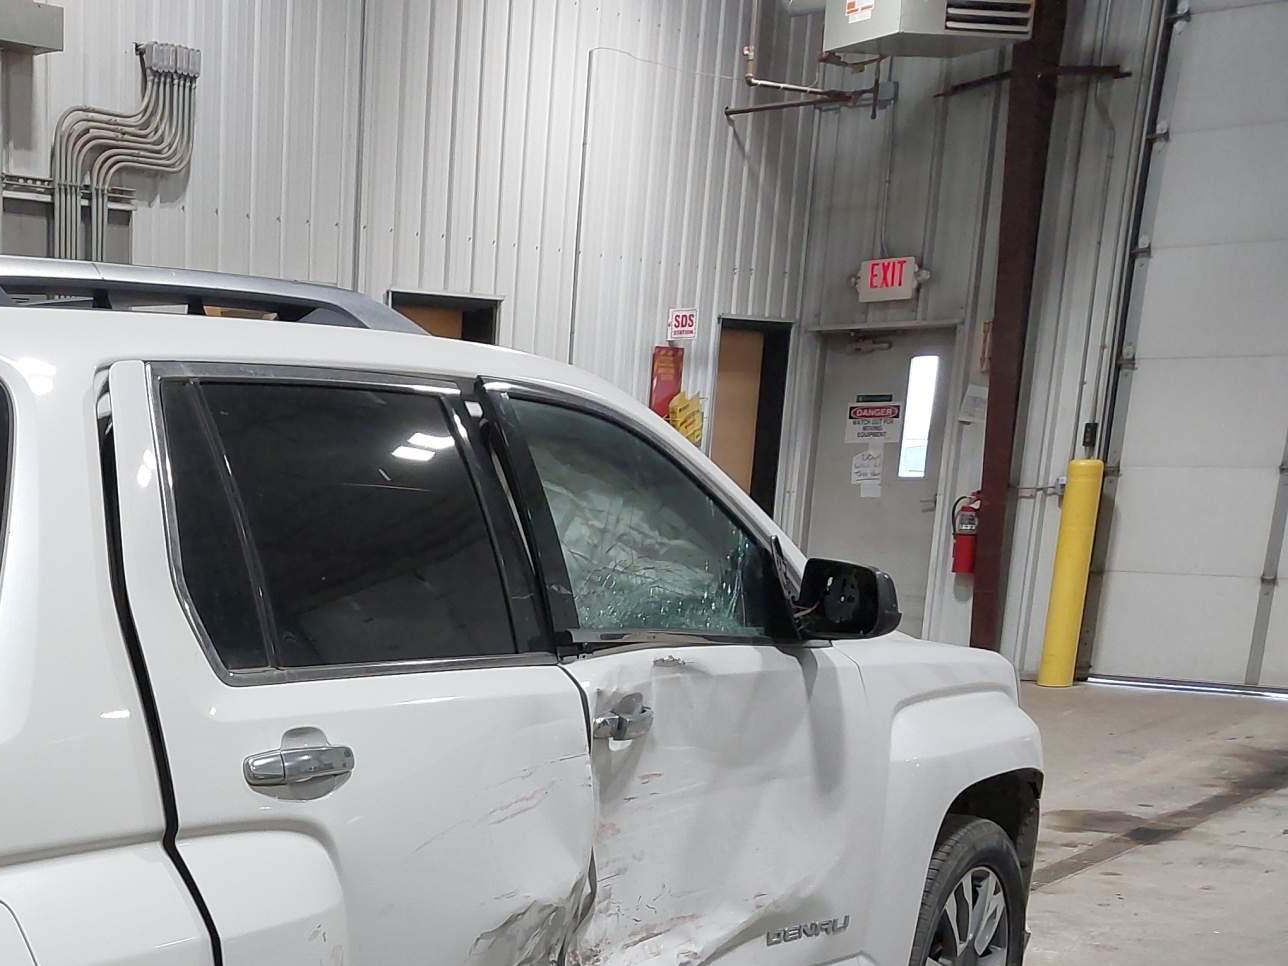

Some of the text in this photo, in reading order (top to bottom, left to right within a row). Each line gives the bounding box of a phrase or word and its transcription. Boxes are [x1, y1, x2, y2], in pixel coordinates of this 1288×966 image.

[869, 260, 907, 289] EXIT
[673, 313, 695, 329] SDS
[855, 408, 893, 417] DANGER
[766, 914, 850, 947] DENALI
